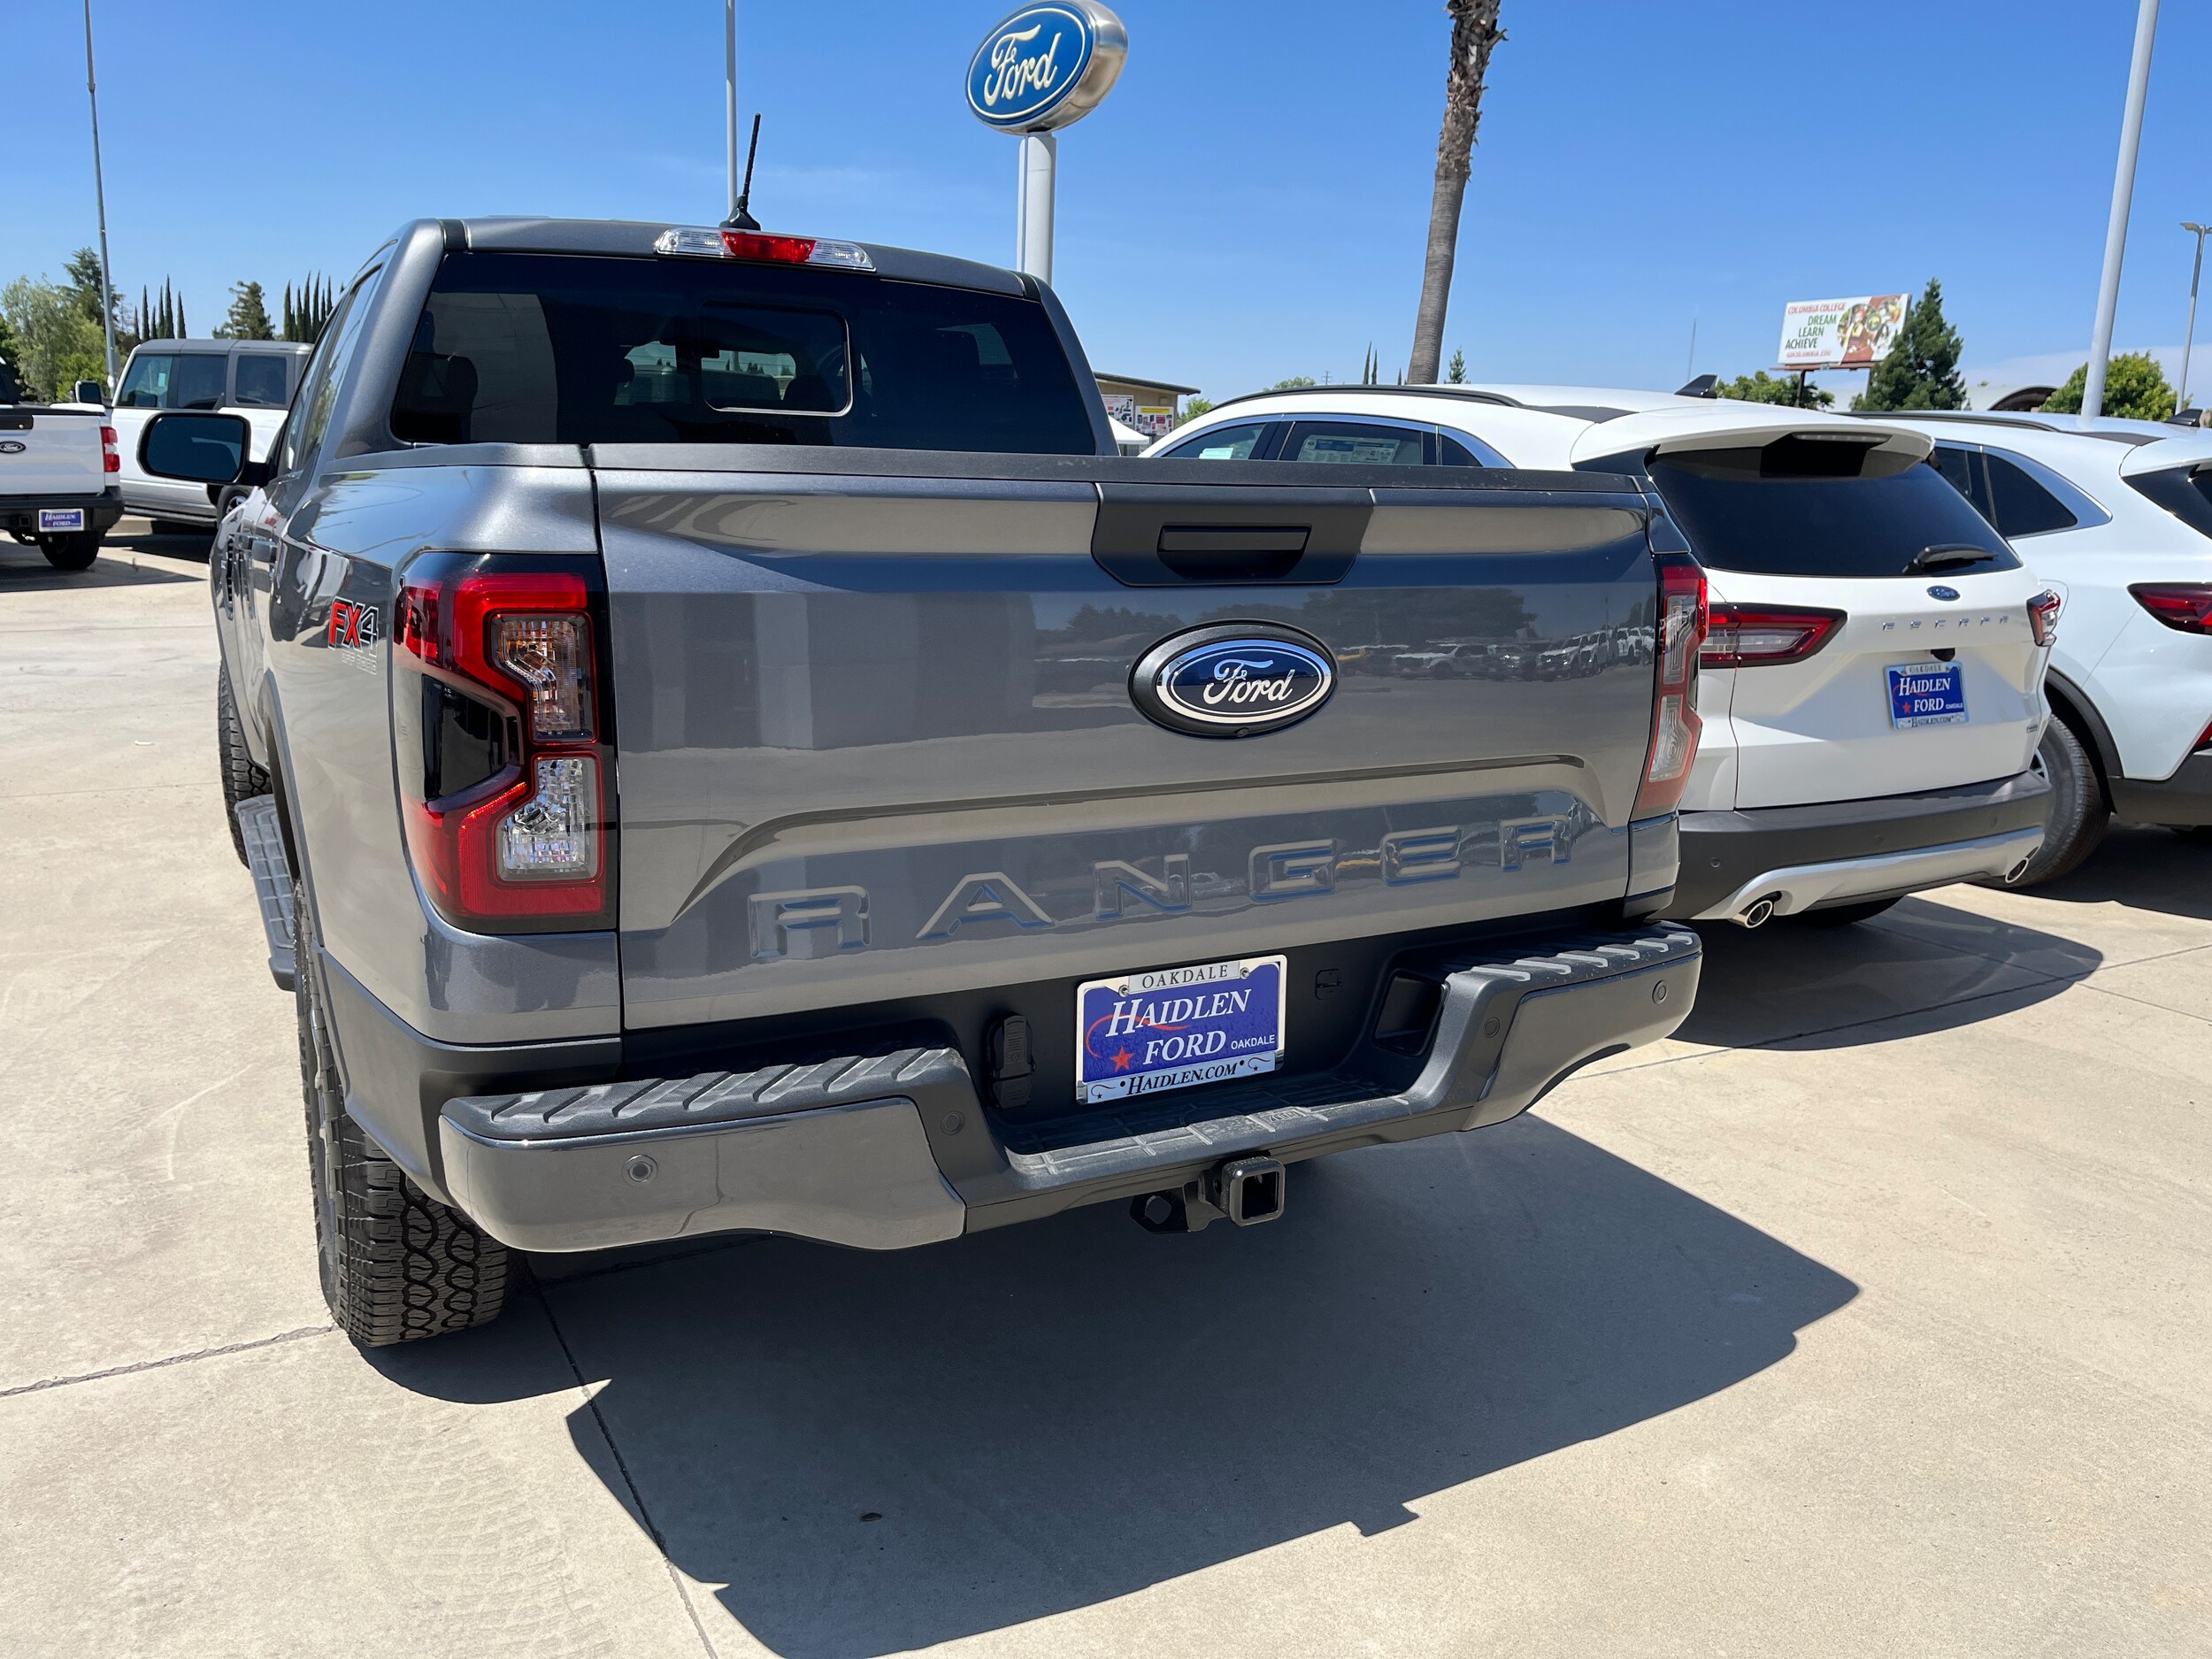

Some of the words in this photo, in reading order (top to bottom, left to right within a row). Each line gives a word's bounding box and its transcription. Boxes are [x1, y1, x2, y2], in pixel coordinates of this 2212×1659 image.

[984, 24, 1062, 107] Ford
[1787, 303, 1819, 314] COLUMBIA
[1820, 302, 1846, 312] COLLEGE
[1808, 314, 1837, 326] DREAM
[1786, 338, 1818, 349] ACHIEVE
[1798, 326, 1824, 337] LEARN
[328, 596, 379, 658] FX4
[1202, 658, 1294, 704] Ford
[1909, 664, 1941, 673] OAKDALE
[1899, 677, 1951, 696] HAIDLEN
[1914, 697, 1944, 712] FORD
[749, 814, 1571, 959] RANGER
[1142, 964, 1228, 989] OAKDALE
[1105, 988, 1252, 1038] HAIDLEN
[1142, 1030, 1226, 1065] FORD
[1231, 1034, 1275, 1050] OAKDALE
[1126, 1062, 1239, 1095] HAIDLEN.COM
